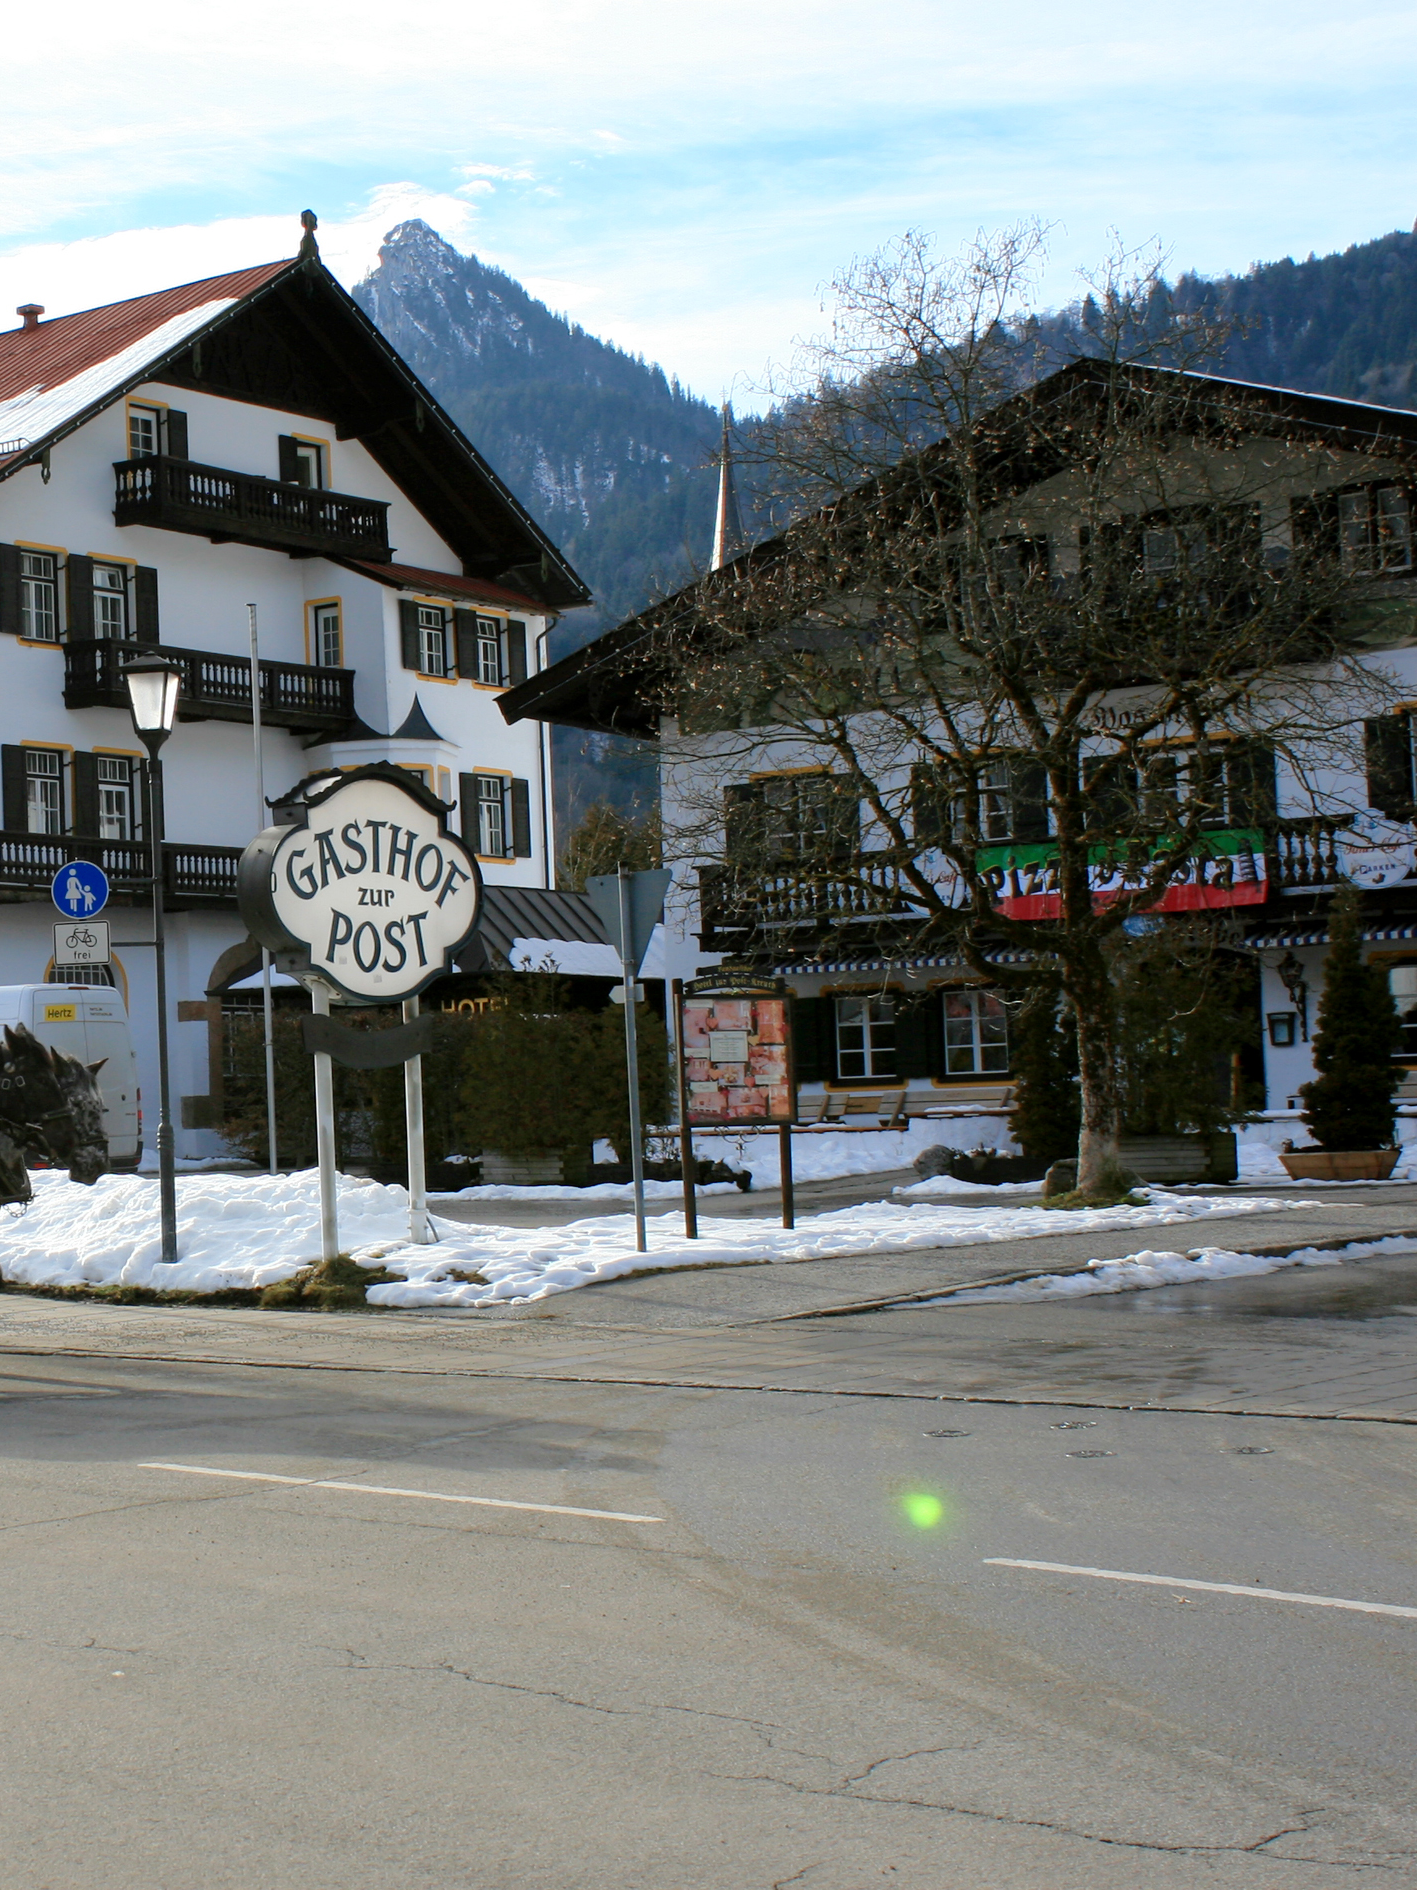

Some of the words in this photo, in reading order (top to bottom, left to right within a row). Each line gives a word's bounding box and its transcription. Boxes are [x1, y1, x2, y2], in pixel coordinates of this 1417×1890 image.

[286, 819, 471, 909] GASTHOF
[356, 887, 395, 907] zur
[325, 907, 429, 974] POST
[73, 950, 91, 960] frei
[47, 1008, 73, 1019] Hertz
